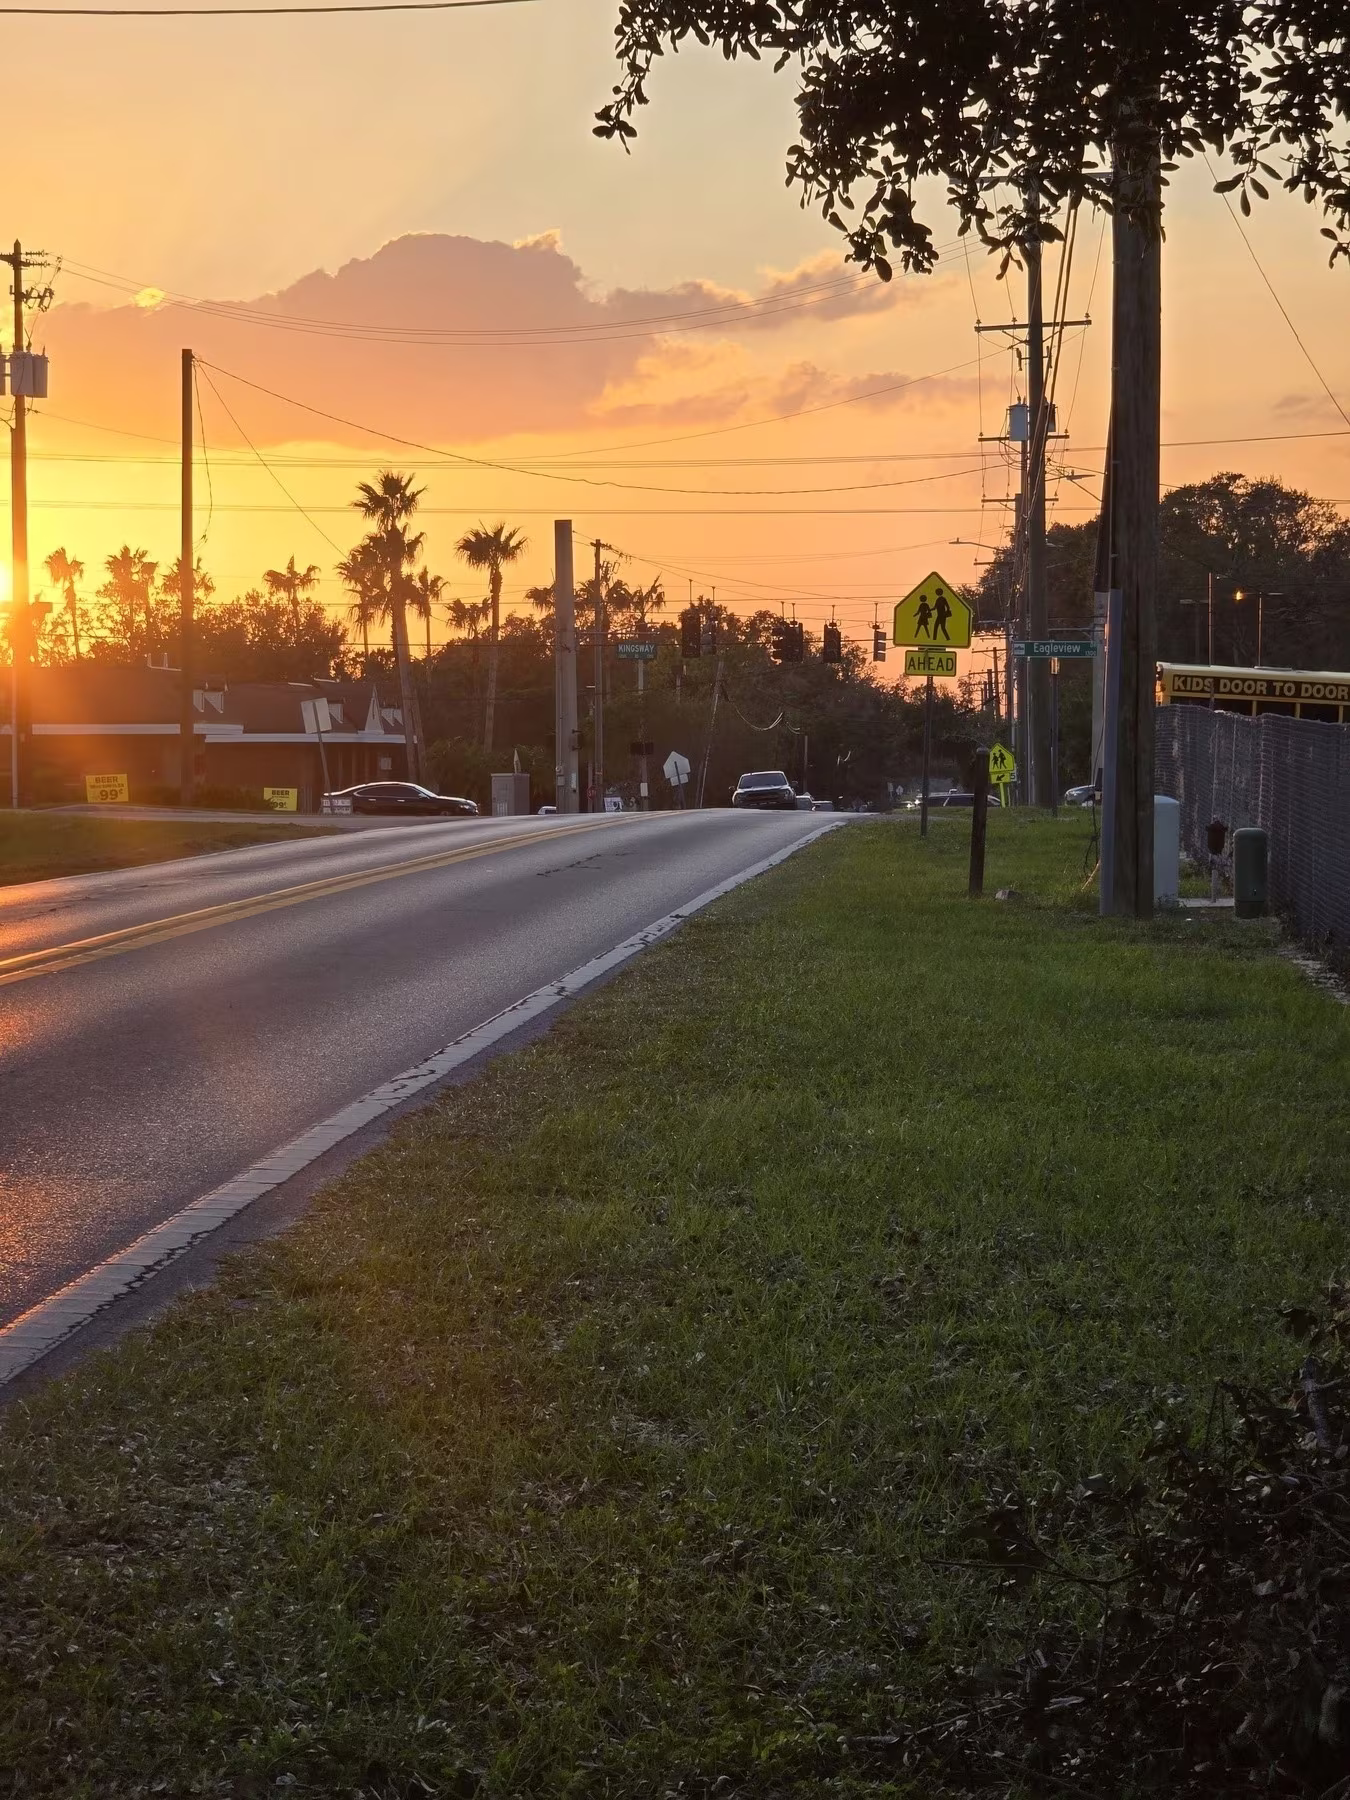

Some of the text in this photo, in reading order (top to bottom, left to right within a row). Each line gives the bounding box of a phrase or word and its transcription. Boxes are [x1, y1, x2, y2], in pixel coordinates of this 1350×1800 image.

[618, 644, 655, 653] KINGSWAY
[1033, 643, 1081, 655] Eagleview
[907, 656, 954, 672] AHEAD
[1174, 675, 1350, 700] KIDS DOOR TO DOOR
[95, 776, 118, 785] BEER
[271, 789, 290, 798] BEER
